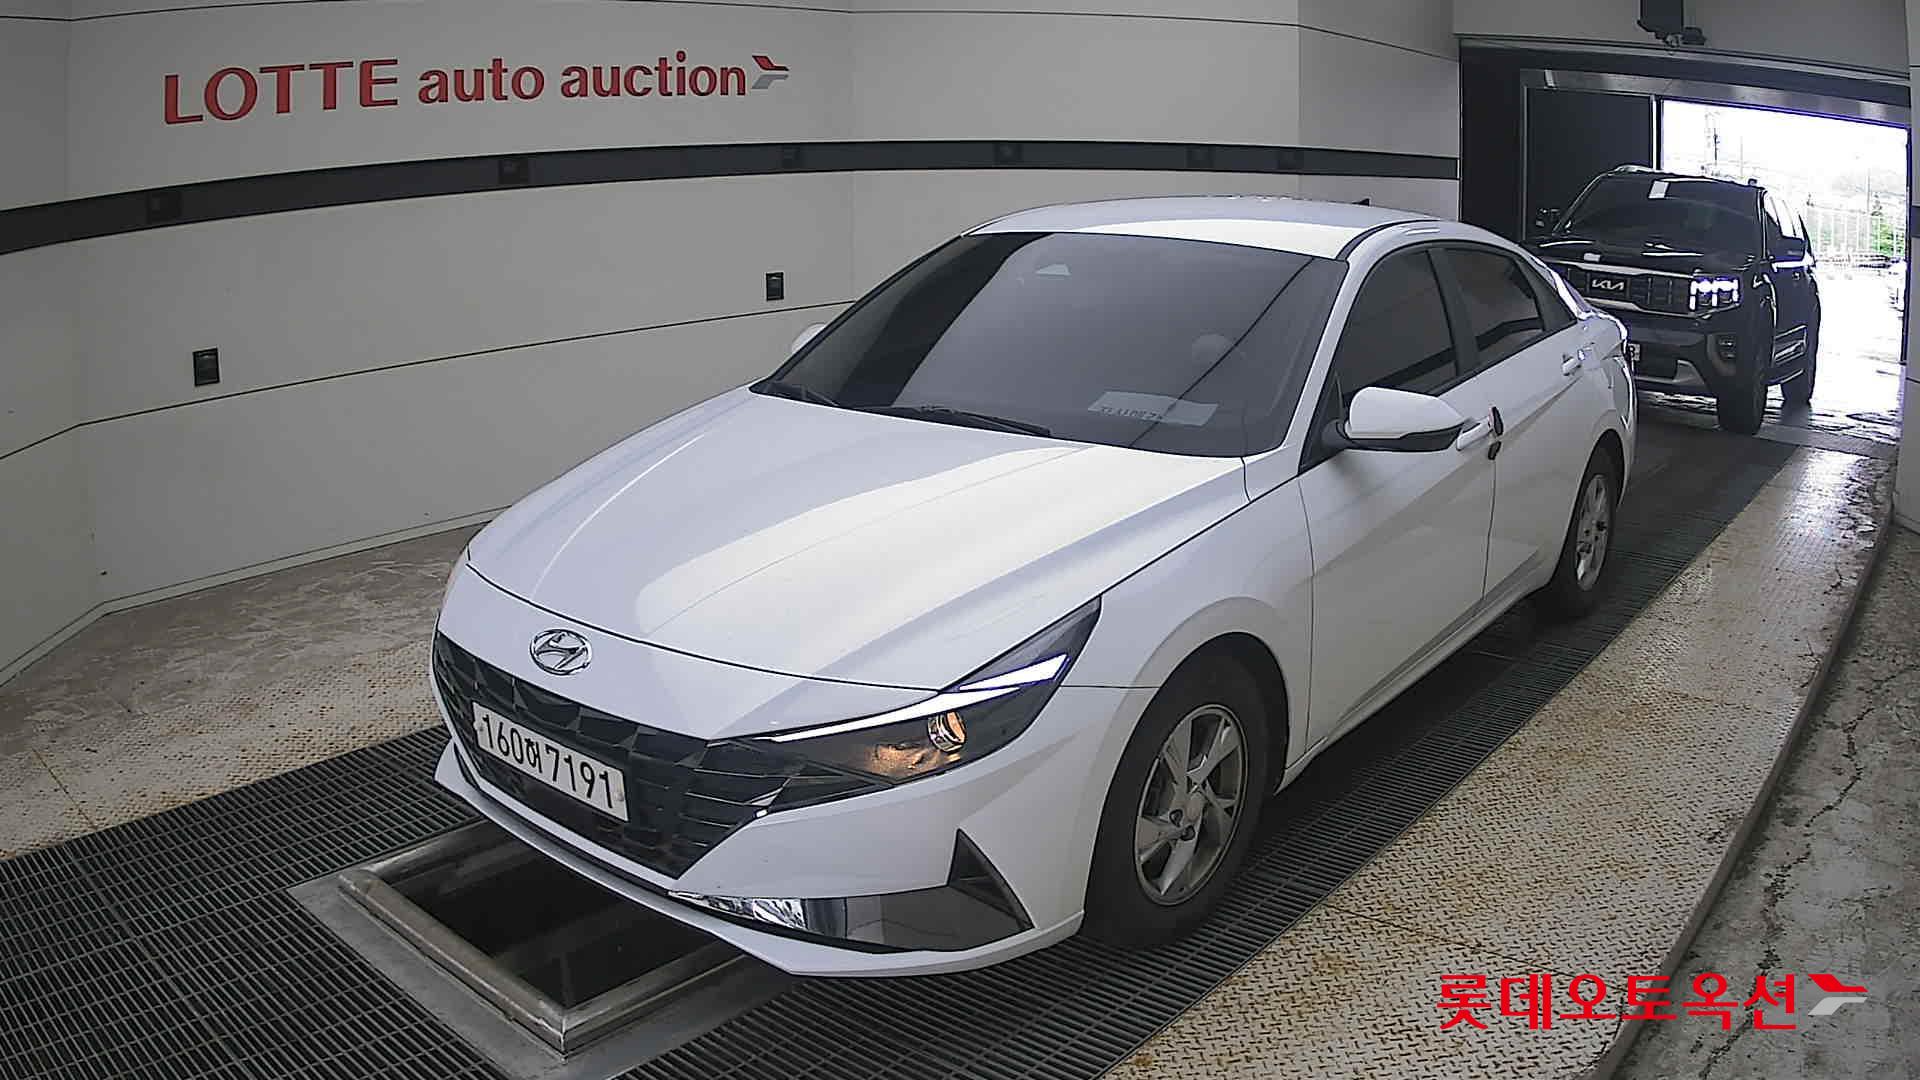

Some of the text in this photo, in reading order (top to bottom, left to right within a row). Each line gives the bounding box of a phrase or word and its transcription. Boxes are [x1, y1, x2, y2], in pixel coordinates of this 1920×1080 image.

[164, 50, 746, 124] LOTTE auto auction
